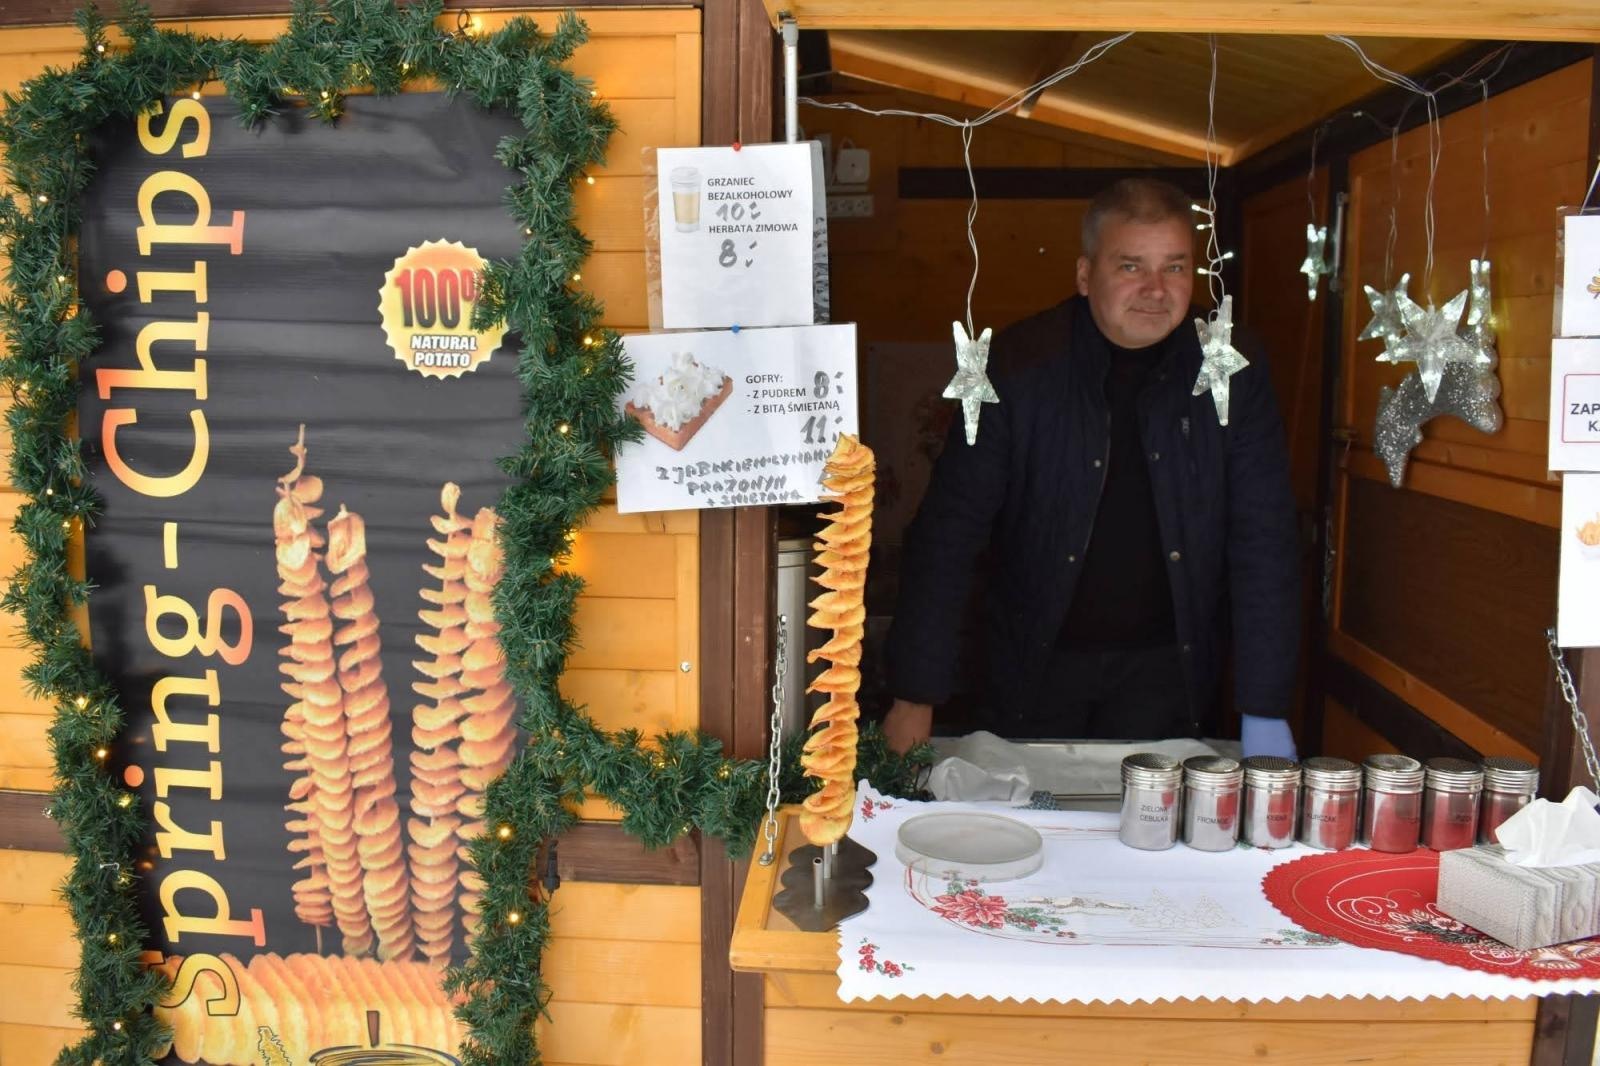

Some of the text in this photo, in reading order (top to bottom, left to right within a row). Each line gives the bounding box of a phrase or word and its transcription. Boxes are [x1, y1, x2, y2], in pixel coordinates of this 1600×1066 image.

[707, 176, 755, 187] GRZANIEC
[707, 189, 793, 201] BEZALKOHOLOWY
[708, 223, 799, 233] HERBATA ZIMOWA
[411, 335, 478, 351] NATURAL
[414, 351, 471, 368] POTATO
[745, 374, 784, 384] GOFRY:
[752, 390, 759, 399] Z
[761, 388, 806, 398] PUDREM
[753, 405, 760, 414] Z
[762, 404, 786, 415] BITĄ
[787, 400, 840, 413] ŚMIETANĄ
[1588, 420, 1600, 432] K
